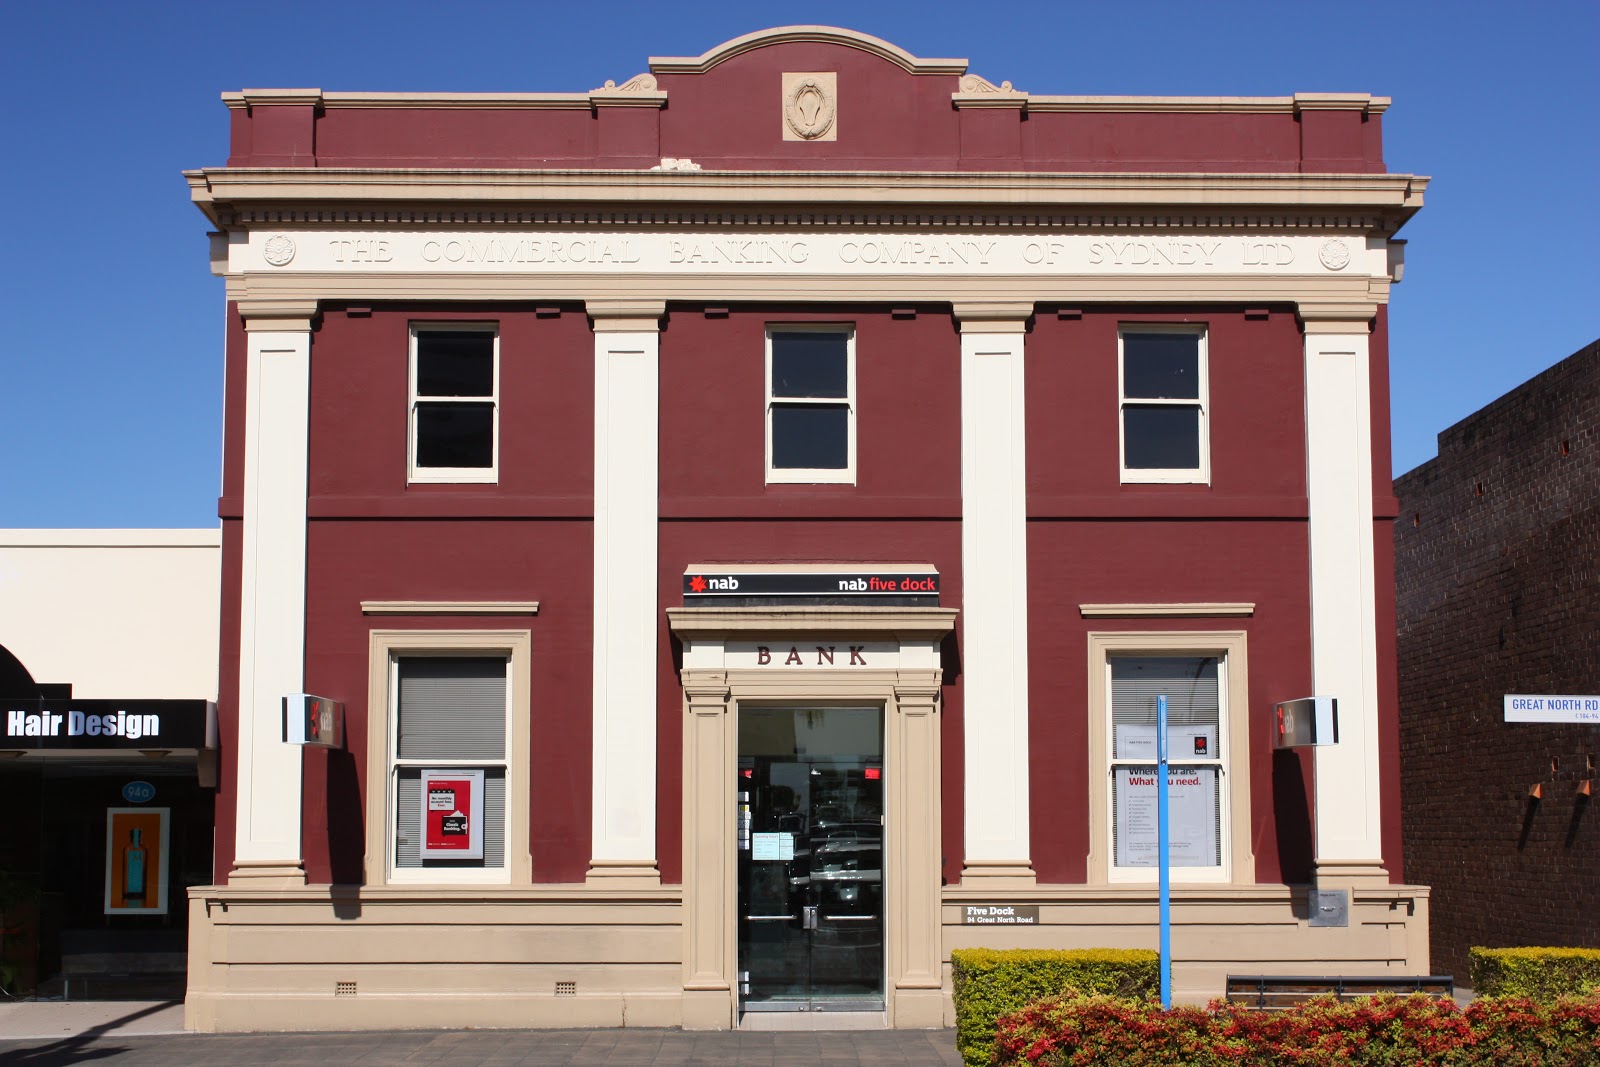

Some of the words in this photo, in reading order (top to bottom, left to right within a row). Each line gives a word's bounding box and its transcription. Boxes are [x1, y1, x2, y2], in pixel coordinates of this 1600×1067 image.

[329, 240, 393, 263] THE
[420, 240, 641, 264] COMMERCIAL
[669, 240, 809, 264] BANKING
[839, 241, 996, 264] COMPANY
[1022, 243, 1064, 265] OF
[1088, 242, 1222, 266] SYDNEY
[1241, 242, 1296, 266] LTD
[708, 576, 739, 590] nab
[839, 578, 868, 591] nab
[869, 577, 896, 591] five
[900, 577, 936, 591] dock
[757, 646, 867, 666] BANK
[1512, 699, 1544, 710] GREAT
[1547, 699, 1581, 711] NORTH
[1585, 699, 1599, 711] RD
[7, 710, 63, 737] Hair
[68, 710, 160, 739] Design
[1129, 766, 1158, 775] Where
[1129, 777, 1154, 785] What
[1176, 777, 1201, 786] need.
[127, 786, 149, 798] 94a
[967, 906, 987, 915] Five
[989, 906, 1014, 915] Dock
